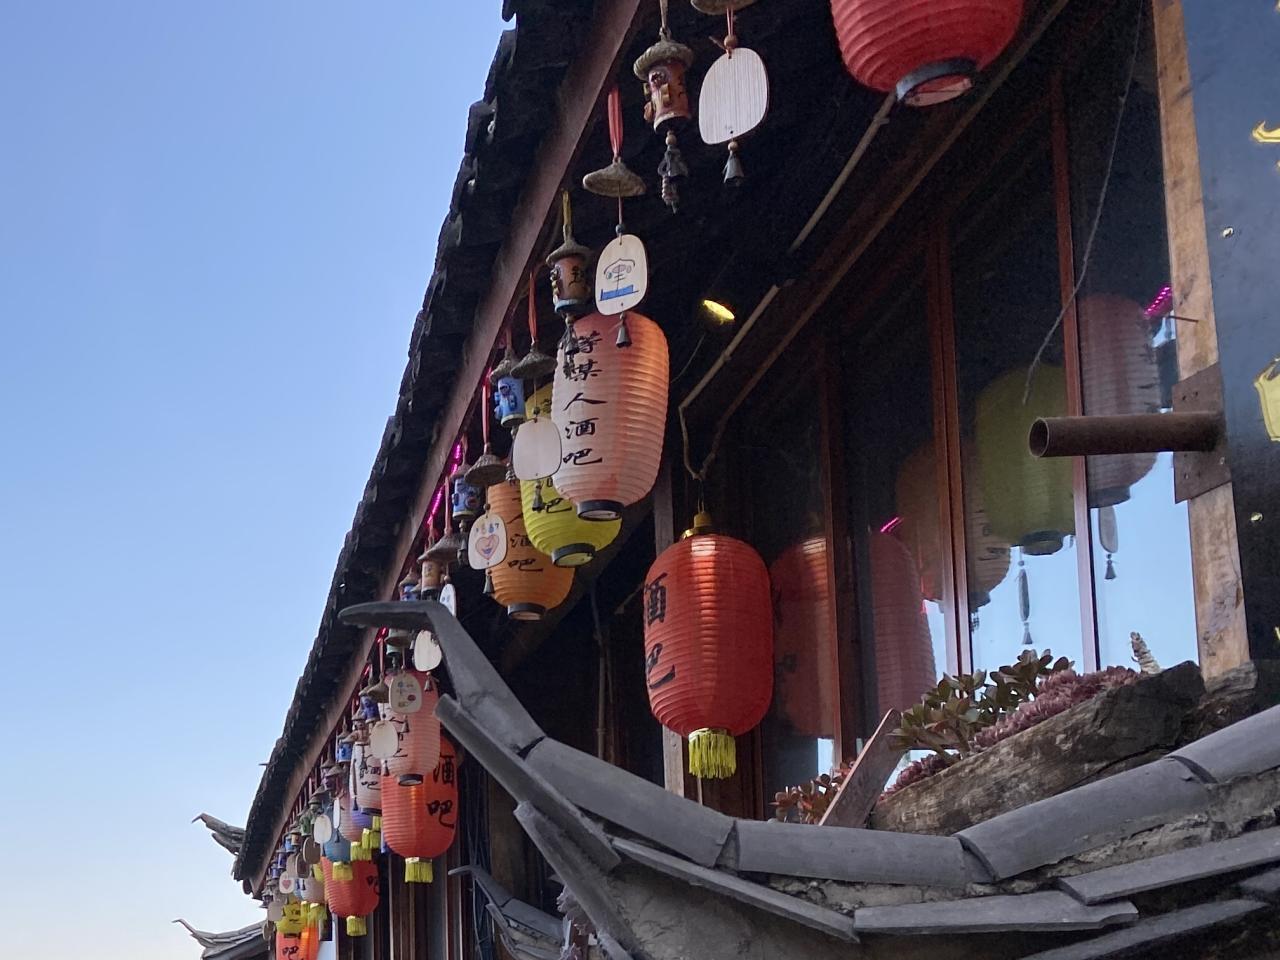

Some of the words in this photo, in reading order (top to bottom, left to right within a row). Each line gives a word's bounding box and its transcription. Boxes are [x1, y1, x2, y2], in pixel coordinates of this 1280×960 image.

[563, 330, 607, 466] 等某人酒吧
[428, 755, 455, 829] 酒吧
